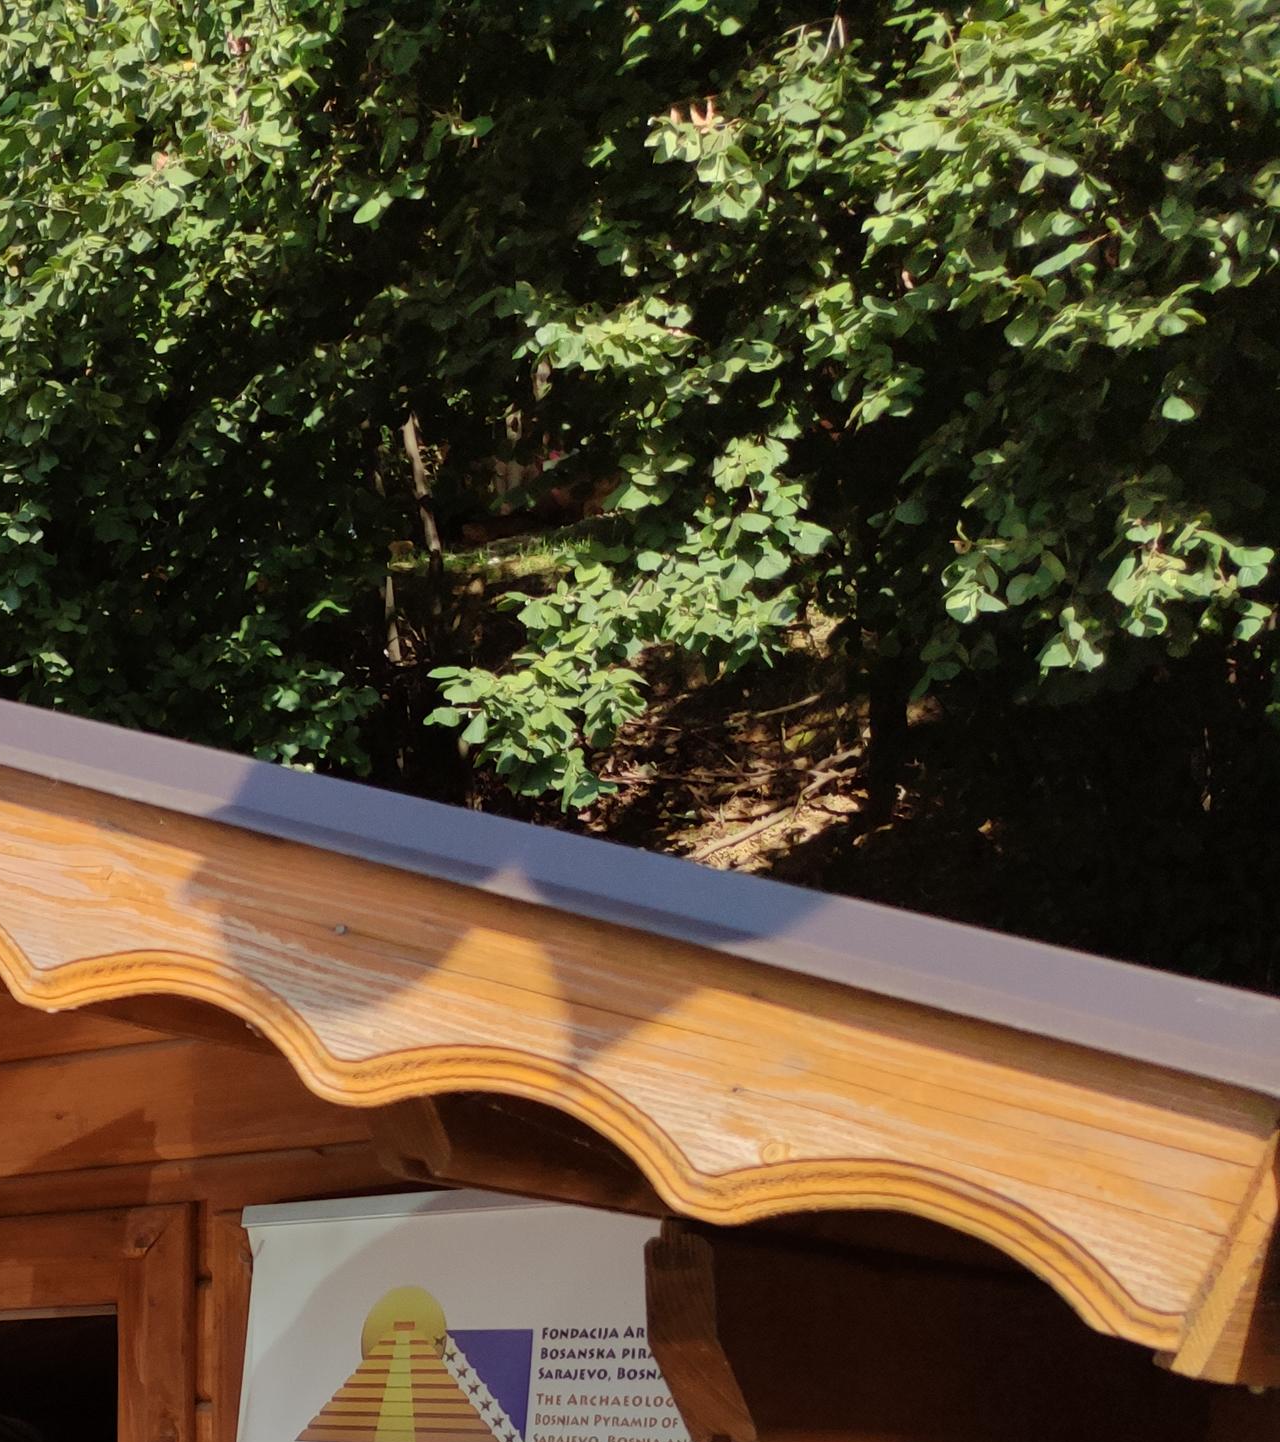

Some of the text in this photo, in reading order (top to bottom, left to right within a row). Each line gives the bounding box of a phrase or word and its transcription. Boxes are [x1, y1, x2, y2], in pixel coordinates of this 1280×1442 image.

[541, 1347, 616, 1360] BOSANSKA
[536, 1393, 562, 1406] THE
[535, 1413, 679, 1429] BOSNIAN PYRAMID OF
